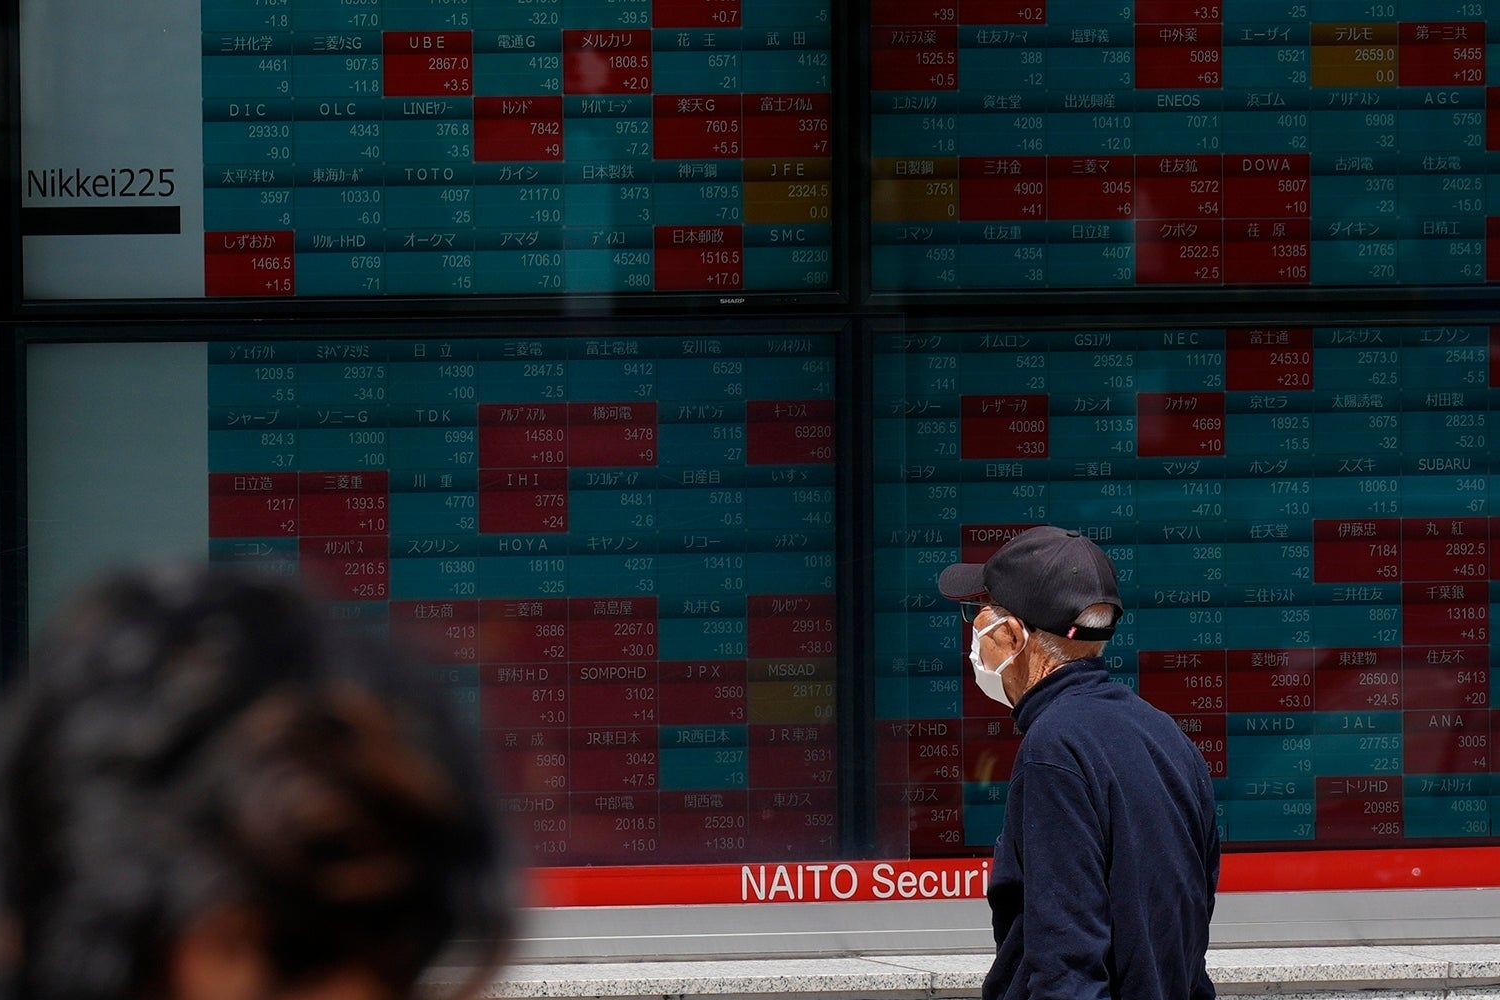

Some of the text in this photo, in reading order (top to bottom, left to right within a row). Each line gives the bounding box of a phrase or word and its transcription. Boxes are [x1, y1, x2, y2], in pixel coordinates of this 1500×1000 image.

[1070, 28, 1110, 44] 塩野義
[1159, 27, 1197, 43] 中外薬
[1241, 26, 1292, 41] エーザイ
[1335, 27, 1373, 41] テルモ
[1415, 24, 1468, 40] 第一三共
[221, 35, 273, 52] 三井化学
[497, 34, 536, 49] 電通G
[581, 32, 632, 48] メルカリ
[708, 54, 737, 68] 6571
[797, 52, 828, 66] 4142
[916, 51, 955, 65] 1525.5
[1101, 50, 1131, 64] 7386
[1189, 49, 1219, 63] 5089
[1277, 48, 1305, 63] 6521
[1355, 48, 1395, 62] 2659.0
[1453, 47, 1483, 61] 5455
[258, 58, 287, 72] 4461
[345, 57, 379, 71] 907.5
[428, 56, 469, 70] 2867.0
[528, 55, 559, 69] 4129
[608, 55, 649, 69] 1808.5
[677, 98, 715, 113] 楽天G
[1157, 94, 1201, 107] ENEOS
[705, 119, 739, 133] 760.5
[798, 118, 828, 132] 3376
[1013, 116, 1043, 130] 4208
[1092, 115, 1131, 129] 1041.0
[1186, 114, 1218, 129] 707.1
[1277, 114, 1307, 128] 4010
[1365, 112, 1395, 127] 6908
[1452, 112, 1482, 126] 5750
[248, 124, 290, 138] 2933.0
[349, 123, 380, 137] 4343
[436, 122, 470, 136] 376.8
[530, 121, 560, 135] 7842
[615, 120, 649, 134] 975.2
[582, 163, 635, 180] 日本製鉄
[677, 162, 718, 178] 神戸鋼
[983, 159, 1022, 175] 三井金
[1072, 159, 1110, 174] 三菱マ
[1158, 158, 1198, 173] 住友鉱
[499, 165, 539, 181] ガイシ
[27, 168, 175, 198] Nikkei225
[1013, 181, 1043, 195] 4900
[1102, 180, 1132, 194] 3045
[1190, 179, 1219, 193] 5272
[1277, 179, 1307, 193] 5807
[1365, 178, 1395, 192] 3376
[1442, 177, 1483, 191] 2402.5
[260, 190, 290, 204] 3597
[340, 189, 381, 203] 1033.0
[440, 188, 471, 202] 4097
[519, 187, 560, 201] 2117.0
[620, 186, 650, 200] 3473
[699, 184, 739, 199] 1879.5
[788, 183, 829, 198] 2324.5
[673, 228, 724, 244] 日本郵政
[1159, 223, 1198, 238] クボタ
[1328, 221, 1380, 237] ダイキン
[224, 234, 276, 250] しずおか
[403, 232, 456, 248] オークマ
[500, 231, 539, 246] アマダ
[700, 250, 740, 264] 1516.5
[791, 249, 829, 263] 82230
[1013, 247, 1043, 260] 4354
[1102, 245, 1132, 259] 4407
[1179, 245, 1220, 259] 2522.5
[1271, 244, 1307, 258] 13385
[251, 256, 291, 270] 1466.5
[351, 255, 381, 269] 6769
[441, 254, 471, 268] 7026
[520, 253, 561, 267] 1706.0
[613, 252, 651, 265] 45240
[1249, 329, 1289, 345] 富士通
[1419, 326, 1471, 343] エプソン
[503, 341, 543, 357] 三菱電
[585, 339, 639, 356] 富士電機
[1015, 355, 1045, 369] 5423
[1269, 351, 1310, 365] 2453.0
[1445, 349, 1486, 363] 2544.5
[254, 367, 295, 380] 1209.5
[343, 365, 385, 379] 2937.5
[438, 364, 475, 378] 14390
[523, 363, 564, 377] 2847.5
[623, 361, 653, 376] 9412
[227, 409, 280, 426] シャープ
[592, 406, 633, 421] 横河電
[1444, 413, 1485, 427] 2823.5
[1008, 419, 1045, 433] 40080
[1192, 417, 1222, 431] 4669
[1368, 415, 1398, 429] 3675
[348, 431, 385, 445] 13000
[444, 429, 474, 444] 6994
[524, 428, 564, 442] 1458.0
[623, 427, 654, 441] 3478
[1162, 459, 1201, 475] マツダ
[1338, 457, 1376, 473] スズキ
[1418, 457, 1471, 471] SUBARU
[323, 474, 363, 490] 三菱重
[1358, 479, 1398, 493] 1806.0
[1455, 477, 1486, 492] 3440
[266, 497, 295, 511] 1217
[345, 496, 385, 510] 1393.5
[534, 493, 565, 507] 3775
[1249, 523, 1289, 539] 任天堂
[1337, 522, 1377, 538] 伊藤忠
[587, 536, 639, 551] キヤノン
[1369, 543, 1398, 557] 7184
[1445, 542, 1486, 556] 2892.5
[344, 561, 386, 576] 2216.5
[528, 559, 565, 572] 18110
[593, 600, 633, 616] 高島屋
[1446, 606, 1486, 620] 1318.0
[613, 622, 654, 636] 2267.0
[1338, 650, 1377, 666] 東建物
[1426, 649, 1465, 664] 住友不
[580, 666, 647, 680] SOMPOHD
[1358, 672, 1399, 686] 2650.0
[625, 687, 655, 701] 3102
[586, 730, 641, 746] JR東日本
[675, 728, 730, 744] JR西日本
[1457, 735, 1487, 748] 3005
[919, 744, 960, 758] 2046.5
[1363, 800, 1400, 814] 20985
[741, 861, 989, 901] NAITO Securi
